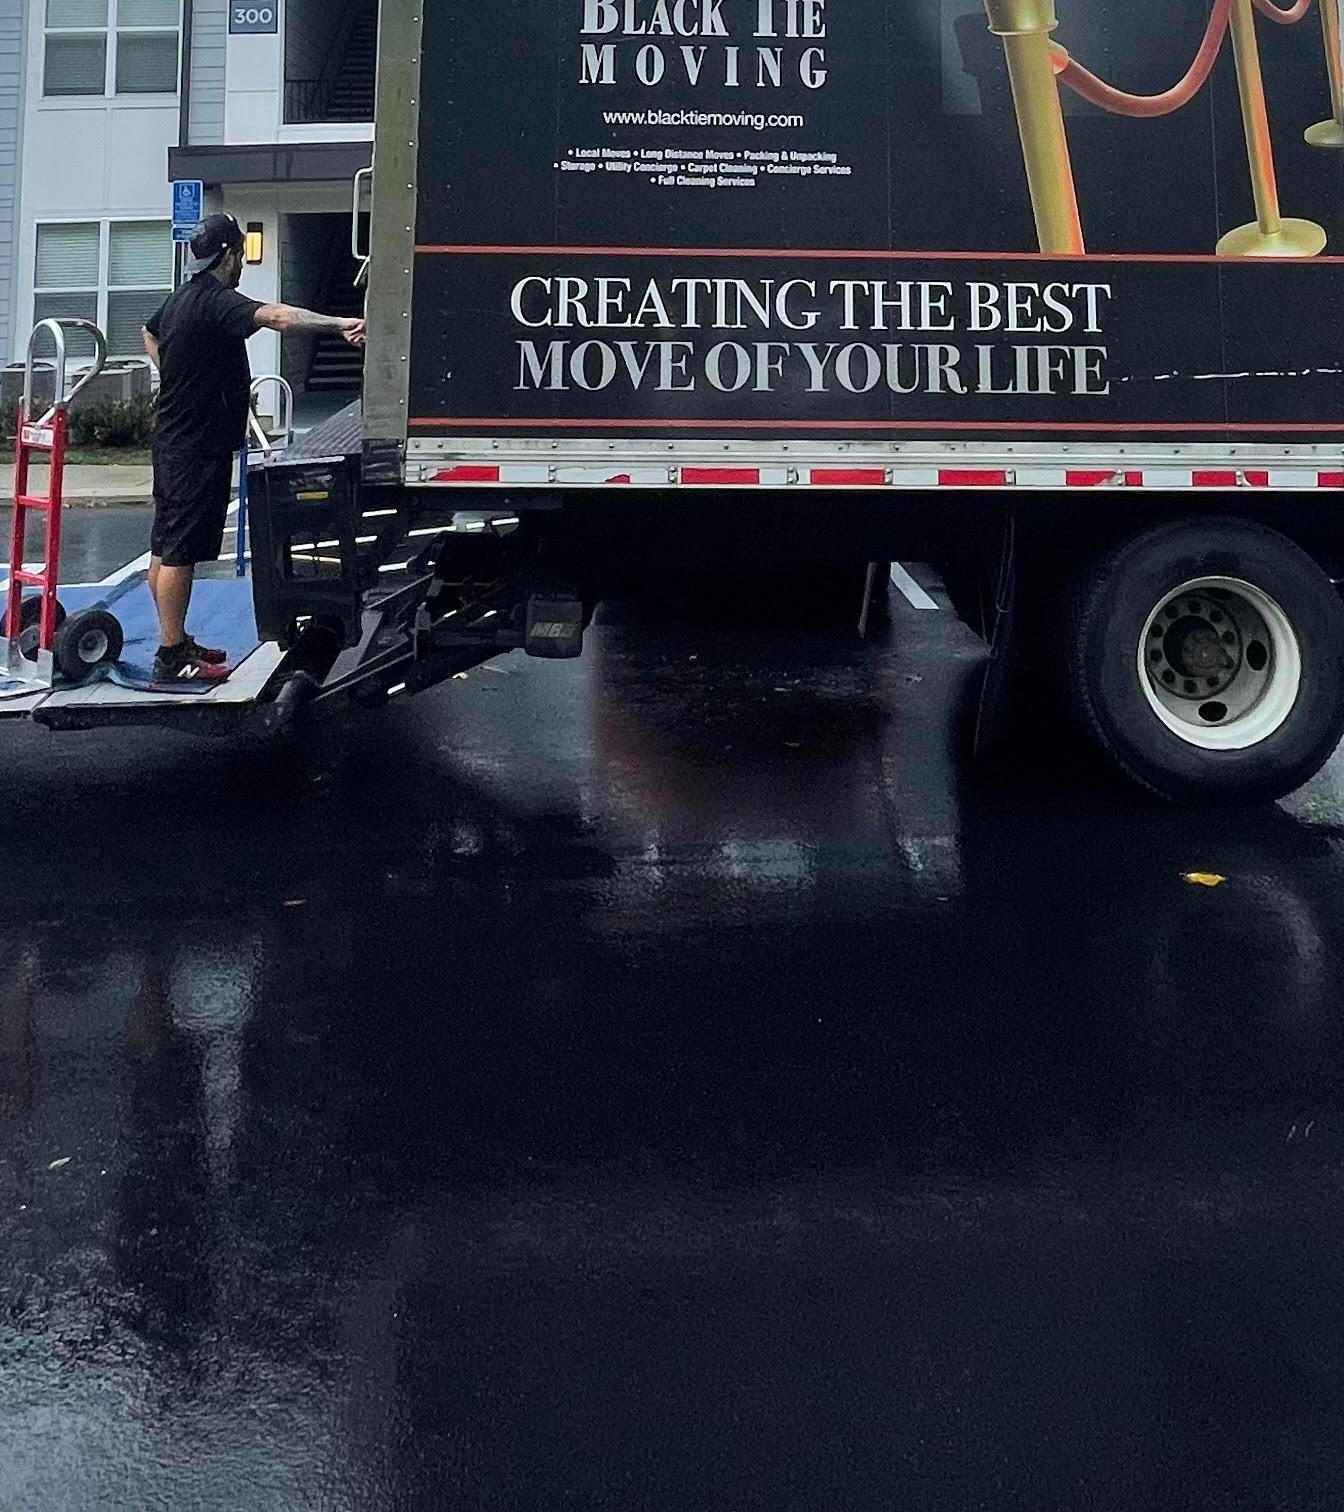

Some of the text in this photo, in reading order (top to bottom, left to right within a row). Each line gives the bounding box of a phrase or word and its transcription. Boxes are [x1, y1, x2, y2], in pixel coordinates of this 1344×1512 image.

[234, 8, 273, 24] 300
[578, 43, 828, 89] MOVING
[603, 110, 804, 130] www.blacktiemoving.com
[576, 148, 600, 158] Local
[641, 149, 663, 160] Long
[665, 149, 704, 160] Distance
[744, 151, 779, 162] Packing
[560, 161, 596, 172] Storage
[605, 162, 632, 173] Utility
[634, 162, 678, 173] Concierge
[688, 163, 718, 174] Carpet
[719, 163, 758, 175] Cleaning
[767, 164, 812, 176] Concierge
[658, 175, 756, 188] Full Cleaning Services
[510, 276, 1111, 333] CREATING THE BEST
[513, 340, 1110, 395] MOVE OF YOUR LIFE
